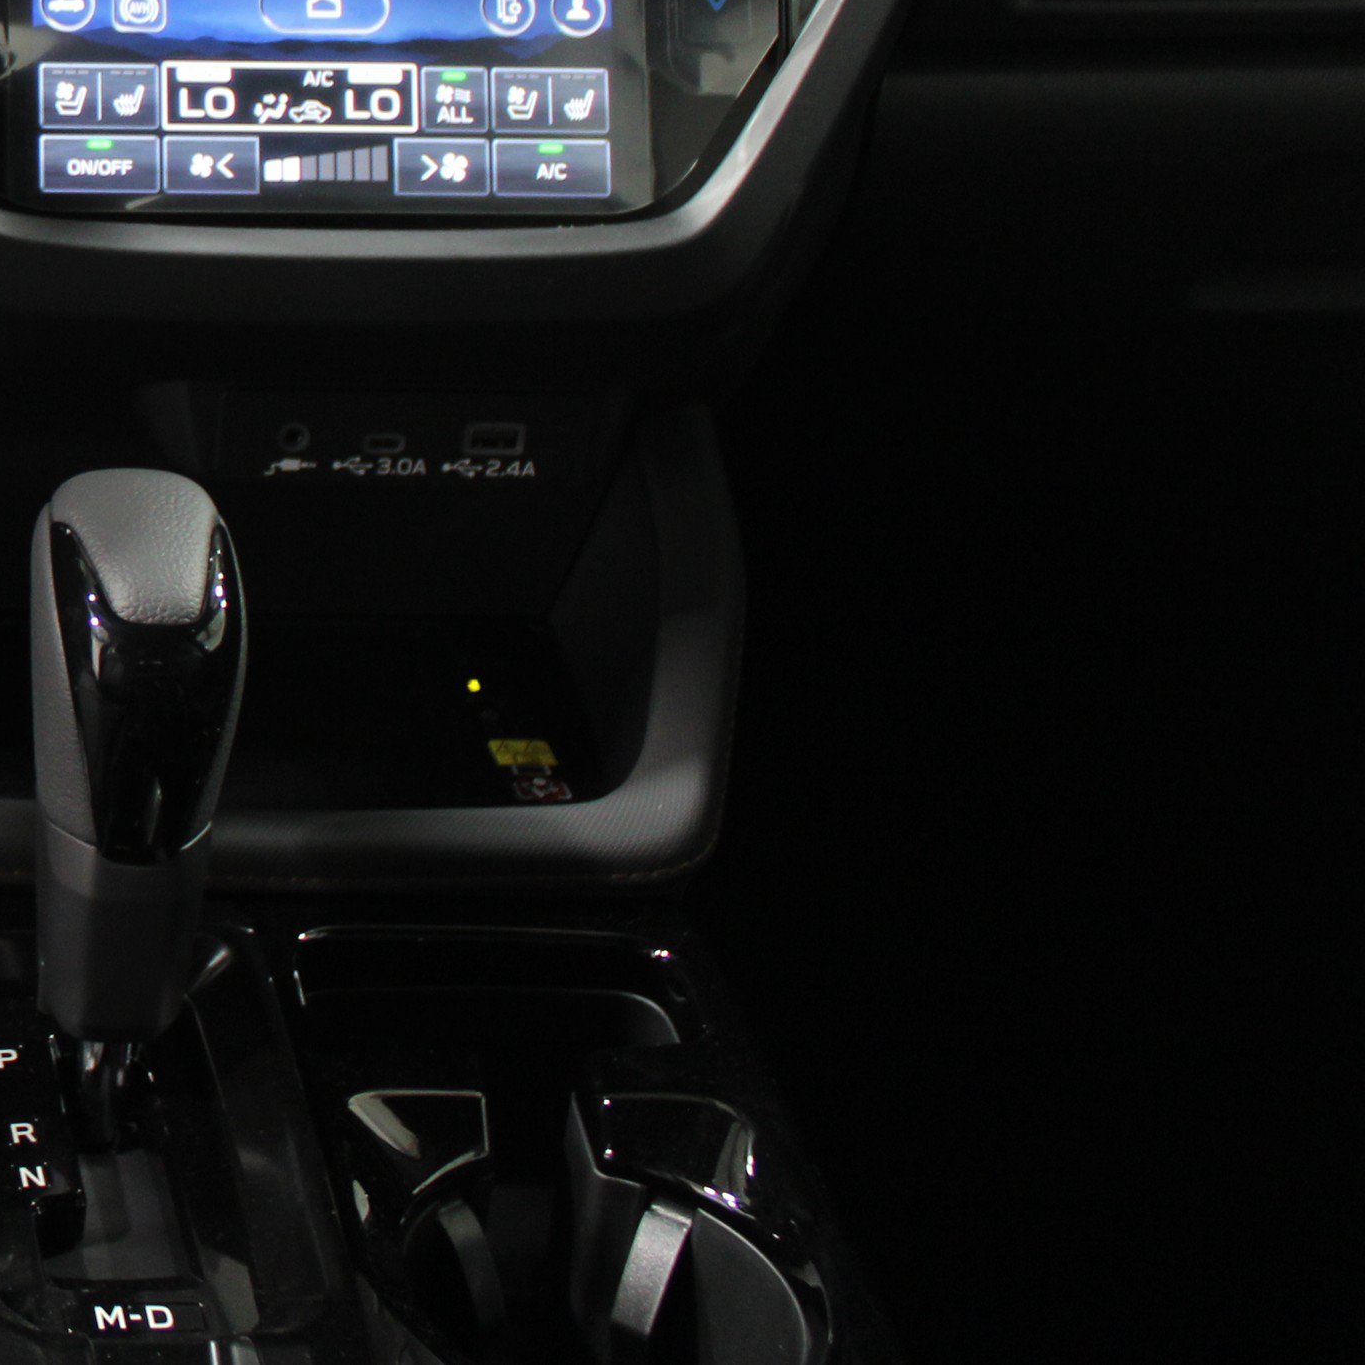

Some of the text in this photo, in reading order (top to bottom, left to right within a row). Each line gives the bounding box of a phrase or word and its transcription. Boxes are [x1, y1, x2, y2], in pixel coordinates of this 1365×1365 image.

[303, 70, 334, 88] A/C
[179, 87, 237, 120] LO
[344, 88, 402, 122] LO
[437, 104, 472, 124] ALL
[67, 158, 133, 177] ON/OFF
[536, 162, 567, 180] A/C
[377, 458, 427, 476] 3.0A
[485, 460, 536, 477] 2.4A
[9, 1122, 37, 1144] R
[19, 1165, 46, 1187] N
[93, 1305, 175, 1330] M-D
